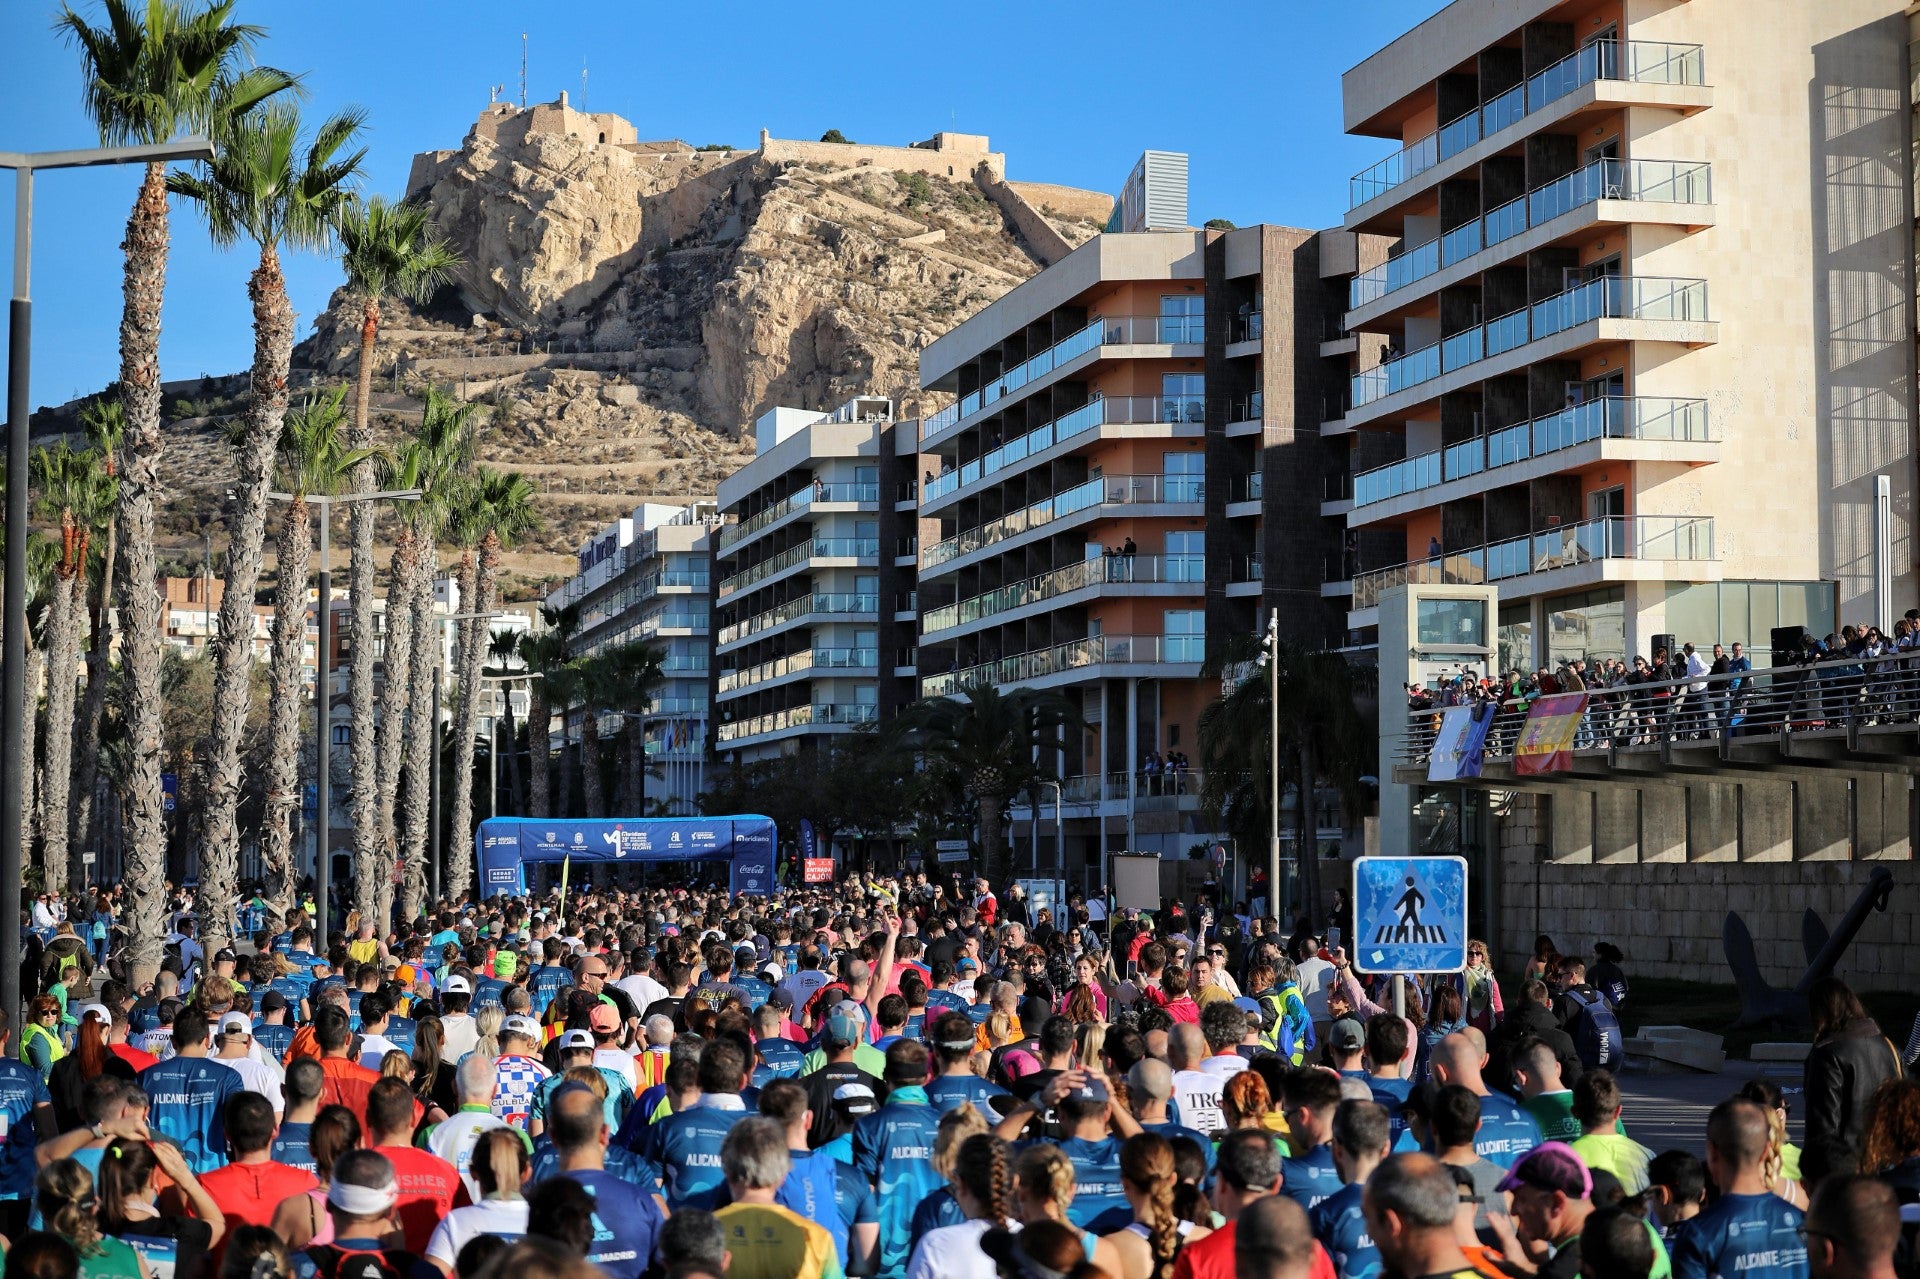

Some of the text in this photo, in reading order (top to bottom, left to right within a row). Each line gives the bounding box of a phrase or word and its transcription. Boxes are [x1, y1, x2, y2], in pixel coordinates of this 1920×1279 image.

[1600, 1031, 1609, 1052] PUMA
[154, 1093, 190, 1104] ALICANTE
[892, 1146, 928, 1159] ALICANTE
[1476, 1139, 1511, 1156] ALICANTE
[686, 1154, 722, 1167] ALICAN
[1076, 1183, 1104, 1194] ANTE
[1734, 1250, 1780, 1271] ALICANTE
